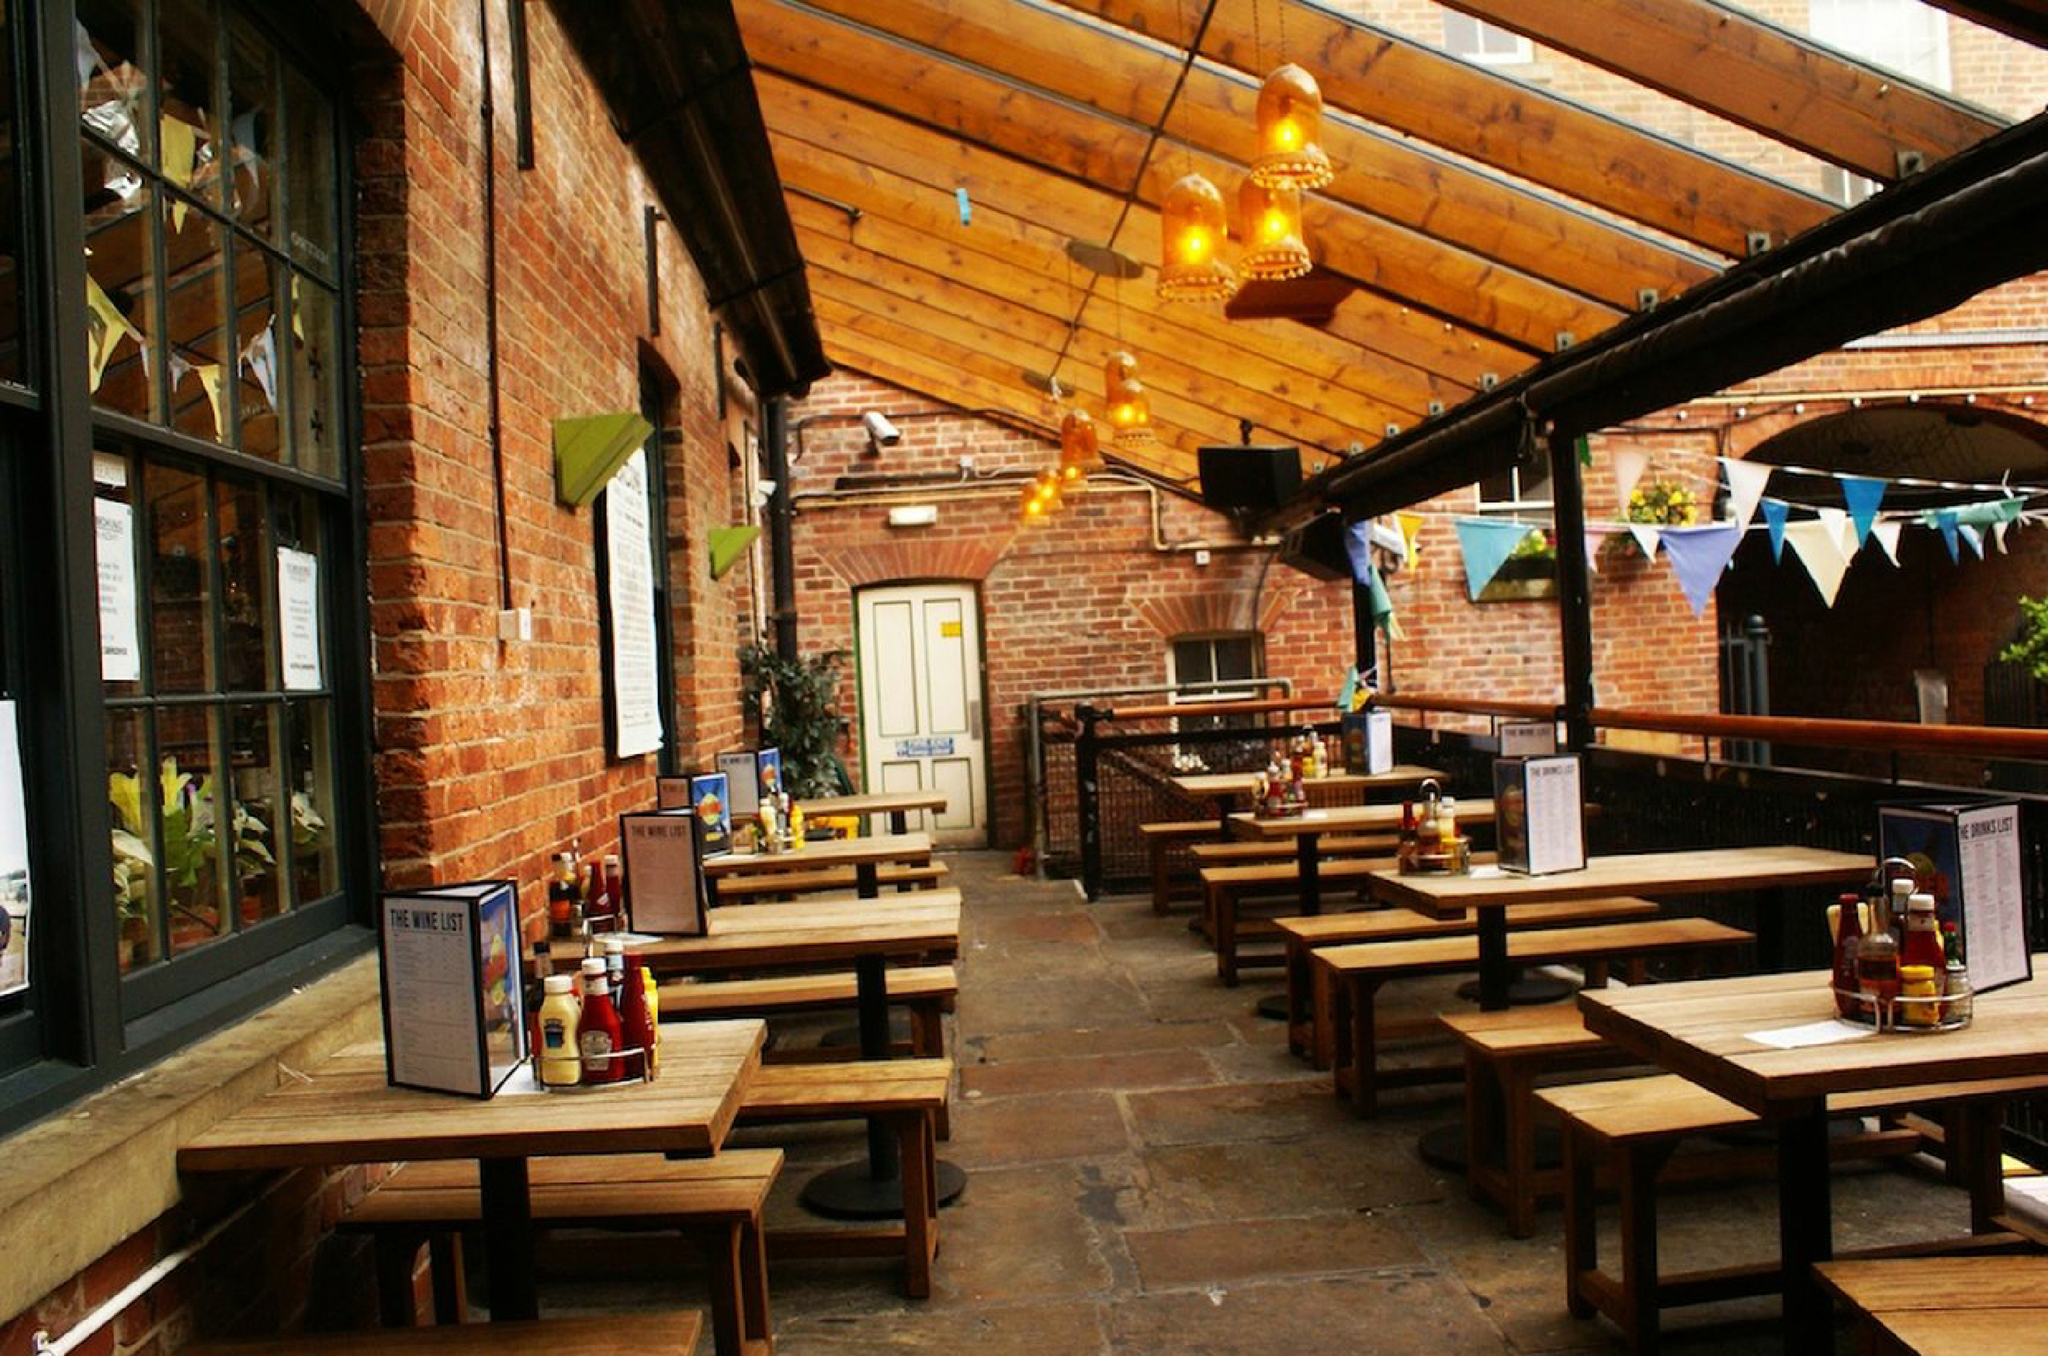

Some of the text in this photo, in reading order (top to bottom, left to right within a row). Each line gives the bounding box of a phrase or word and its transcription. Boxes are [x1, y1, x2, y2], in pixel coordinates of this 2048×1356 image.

[631, 824, 686, 838] THE WINE LIST
[1971, 819, 1996, 838] DRINKS
[1997, 816, 2012, 833] LIST
[390, 908, 464, 932] THE WINE LIST
